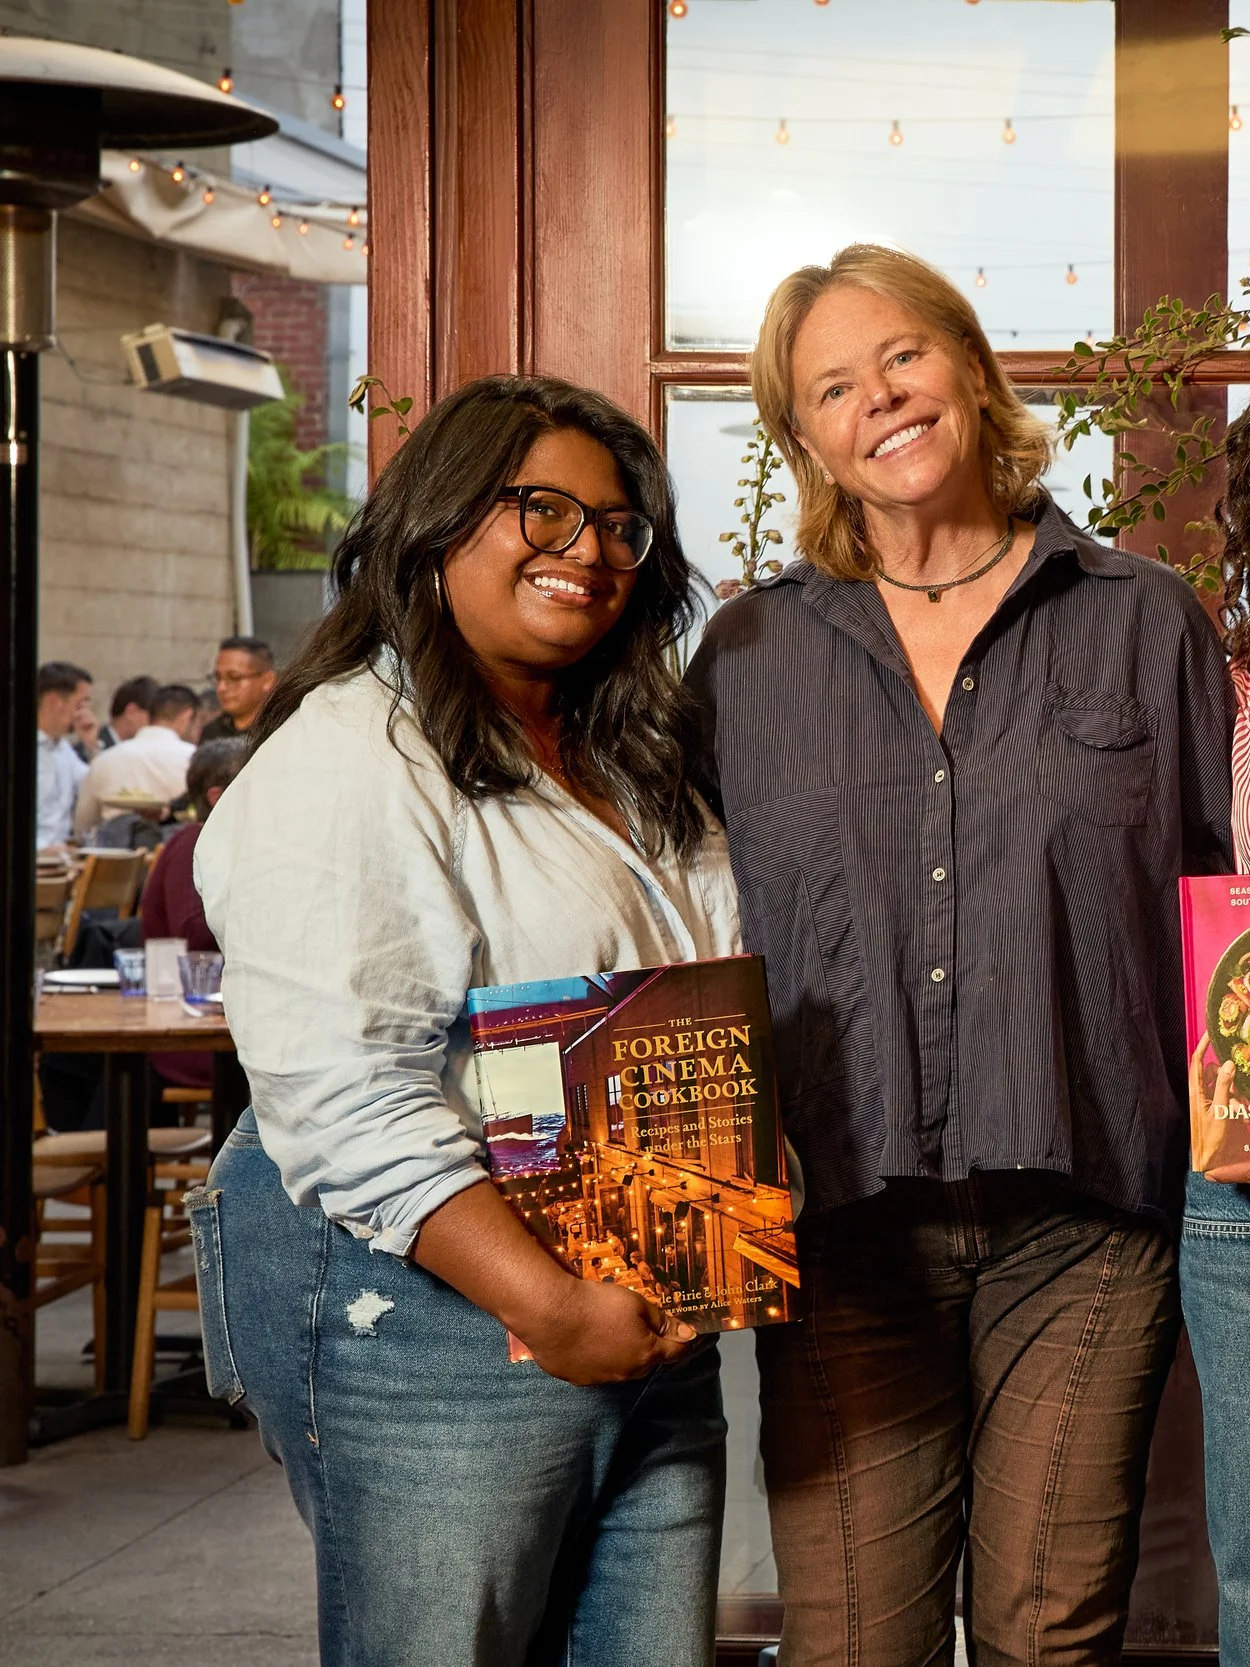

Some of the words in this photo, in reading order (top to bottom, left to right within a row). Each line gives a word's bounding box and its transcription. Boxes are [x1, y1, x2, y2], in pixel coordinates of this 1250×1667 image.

[668, 1017, 692, 1028] THE
[612, 1025, 751, 1061] FOREIGN
[619, 1053, 752, 1087] CINEMA
[618, 1078, 758, 1110] COOKBOOK
[631, 1123, 680, 1140] Recipes
[683, 1117, 707, 1132] and
[708, 1113, 753, 1129] Stories
[644, 1139, 684, 1154] under
[686, 1135, 707, 1149] the
[709, 1133, 742, 1146] Stars
[673, 1289, 702, 1302] Pirie
[703, 1286, 711, 1298] &
[715, 1283, 742, 1297] John
[745, 1277, 778, 1291] Clark
[711, 1300, 731, 1309] Alice
[734, 1295, 763, 1305] Waters
